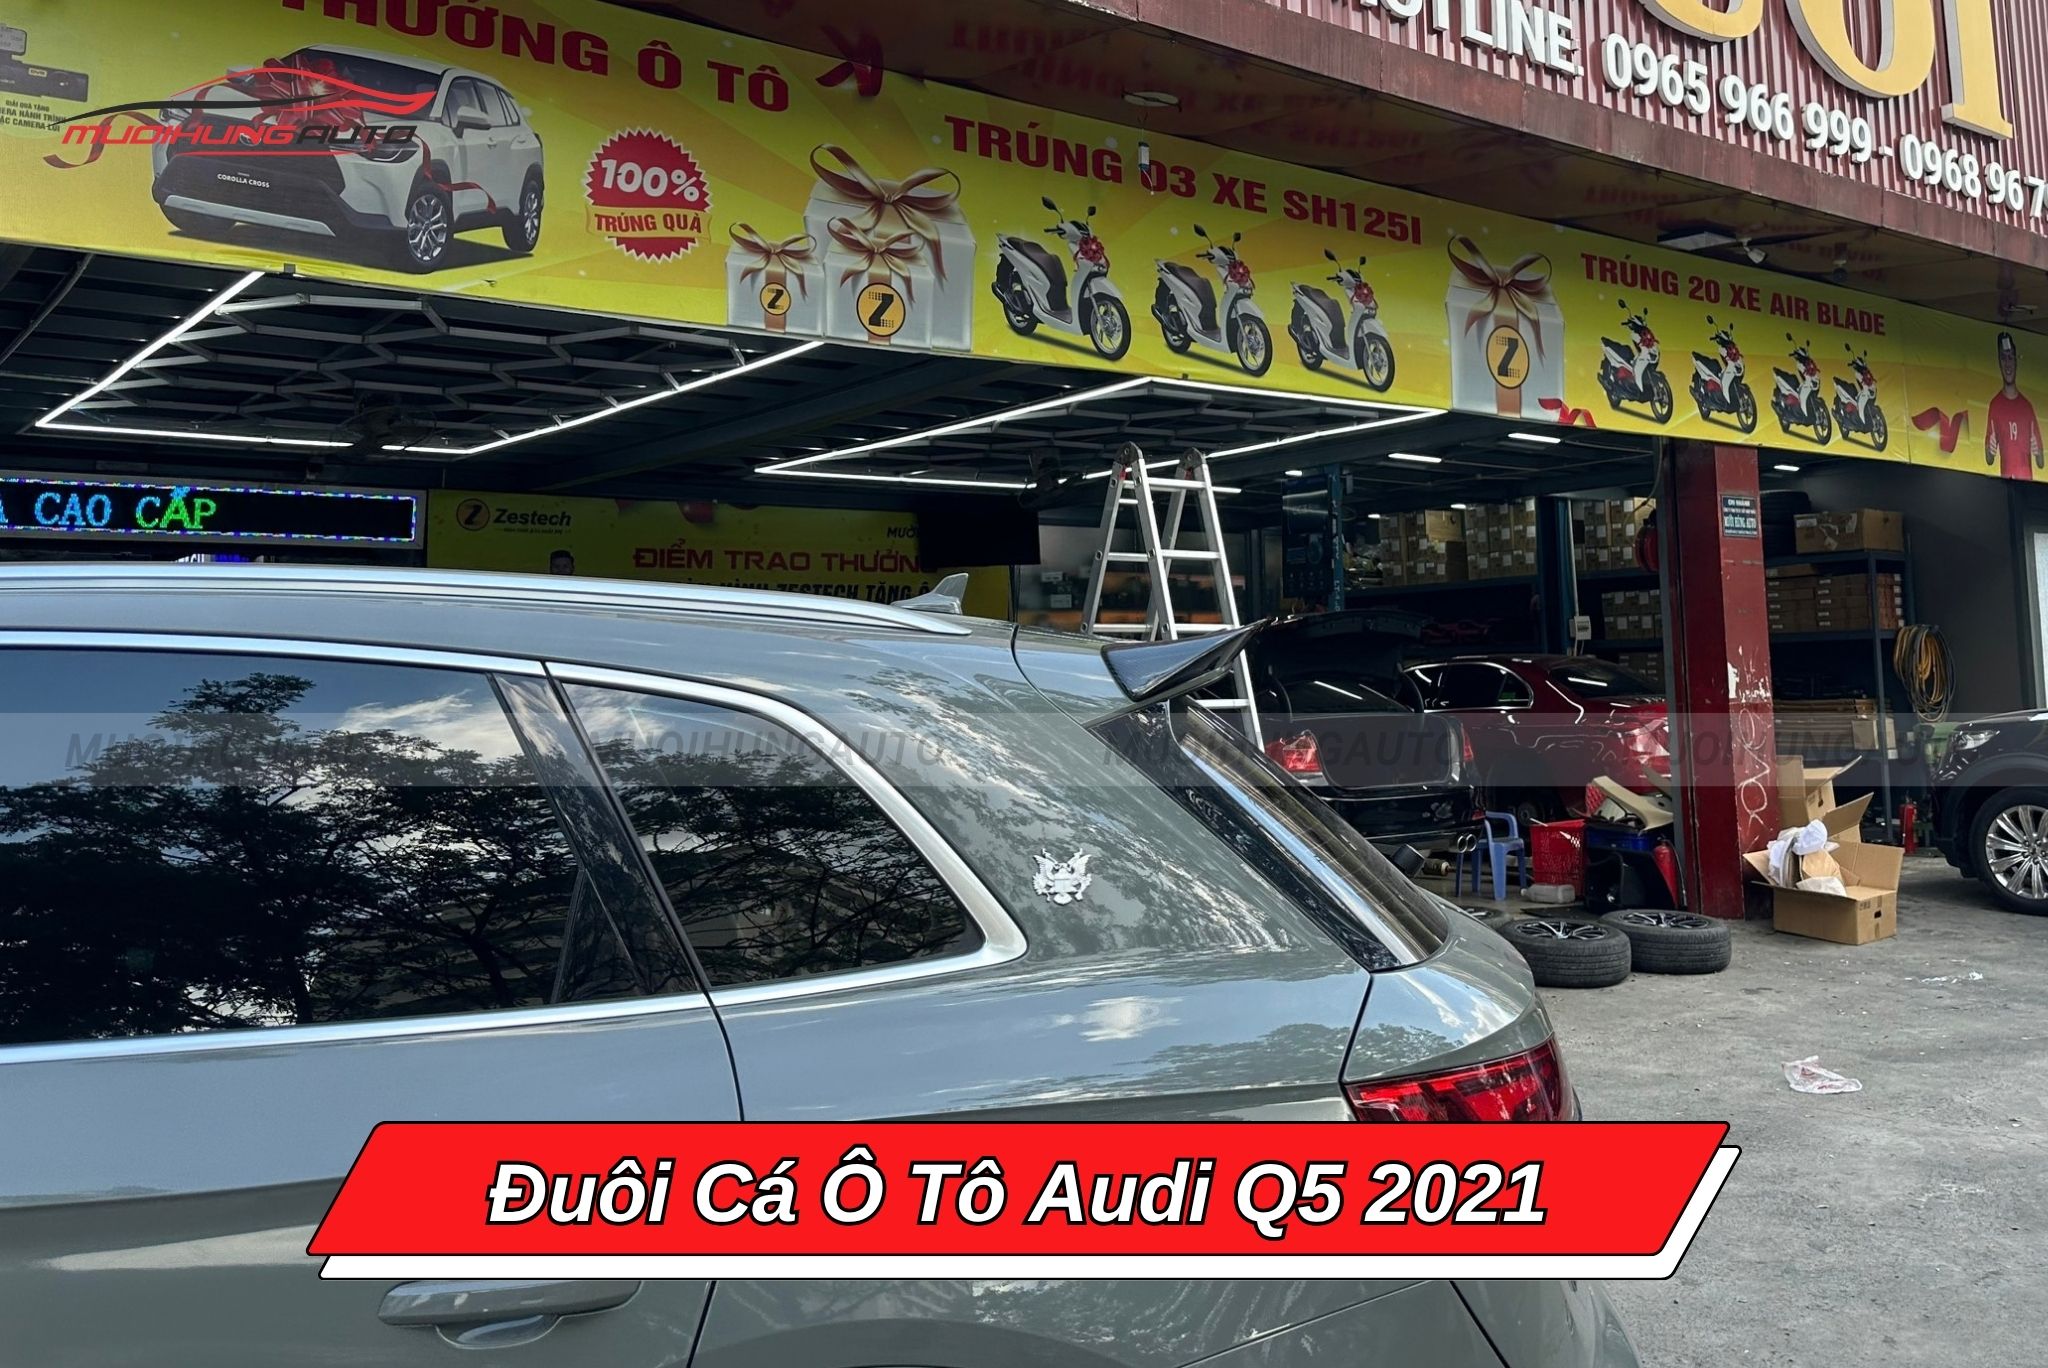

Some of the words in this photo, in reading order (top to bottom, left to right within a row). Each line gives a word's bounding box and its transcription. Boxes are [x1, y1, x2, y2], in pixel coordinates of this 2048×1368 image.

[281, 0, 608, 76] HƯỞNG
[638, 40, 682, 89] Ô
[707, 61, 789, 112] TÔ
[1603, 33, 1710, 115] 0965
[1719, 75, 1794, 140] 966
[1901, 133, 1981, 198] 0968
[1985, 161, 2048, 218] 967
[217, 173, 247, 184] COROLLA
[248, 179, 270, 188] CROSS
[602, 159, 699, 202] 100%
[944, 115, 1122, 184] TRÚNG
[1140, 162, 1197, 198] 03
[1212, 173, 1268, 214] XE
[1283, 189, 1422, 246] SH125I
[594, 212, 657, 232] TRÚNG
[662, 212, 702, 233] QUÀ
[1581, 253, 1679, 296] TRÚNG
[1688, 276, 1720, 304] 20
[1729, 283, 1762, 312] XE
[1770, 293, 1810, 321] AIR
[1817, 301, 1886, 336] BLADE
[2008, 421, 2018, 441] 19
[34, 491, 112, 527] CAO
[136, 486, 217, 529] CẤP
[493, 508, 572, 527] Zestech
[633, 538, 713, 569] ĐIỂM
[725, 551, 811, 572] TRAO
[821, 547, 938, 573] THƯỞN
